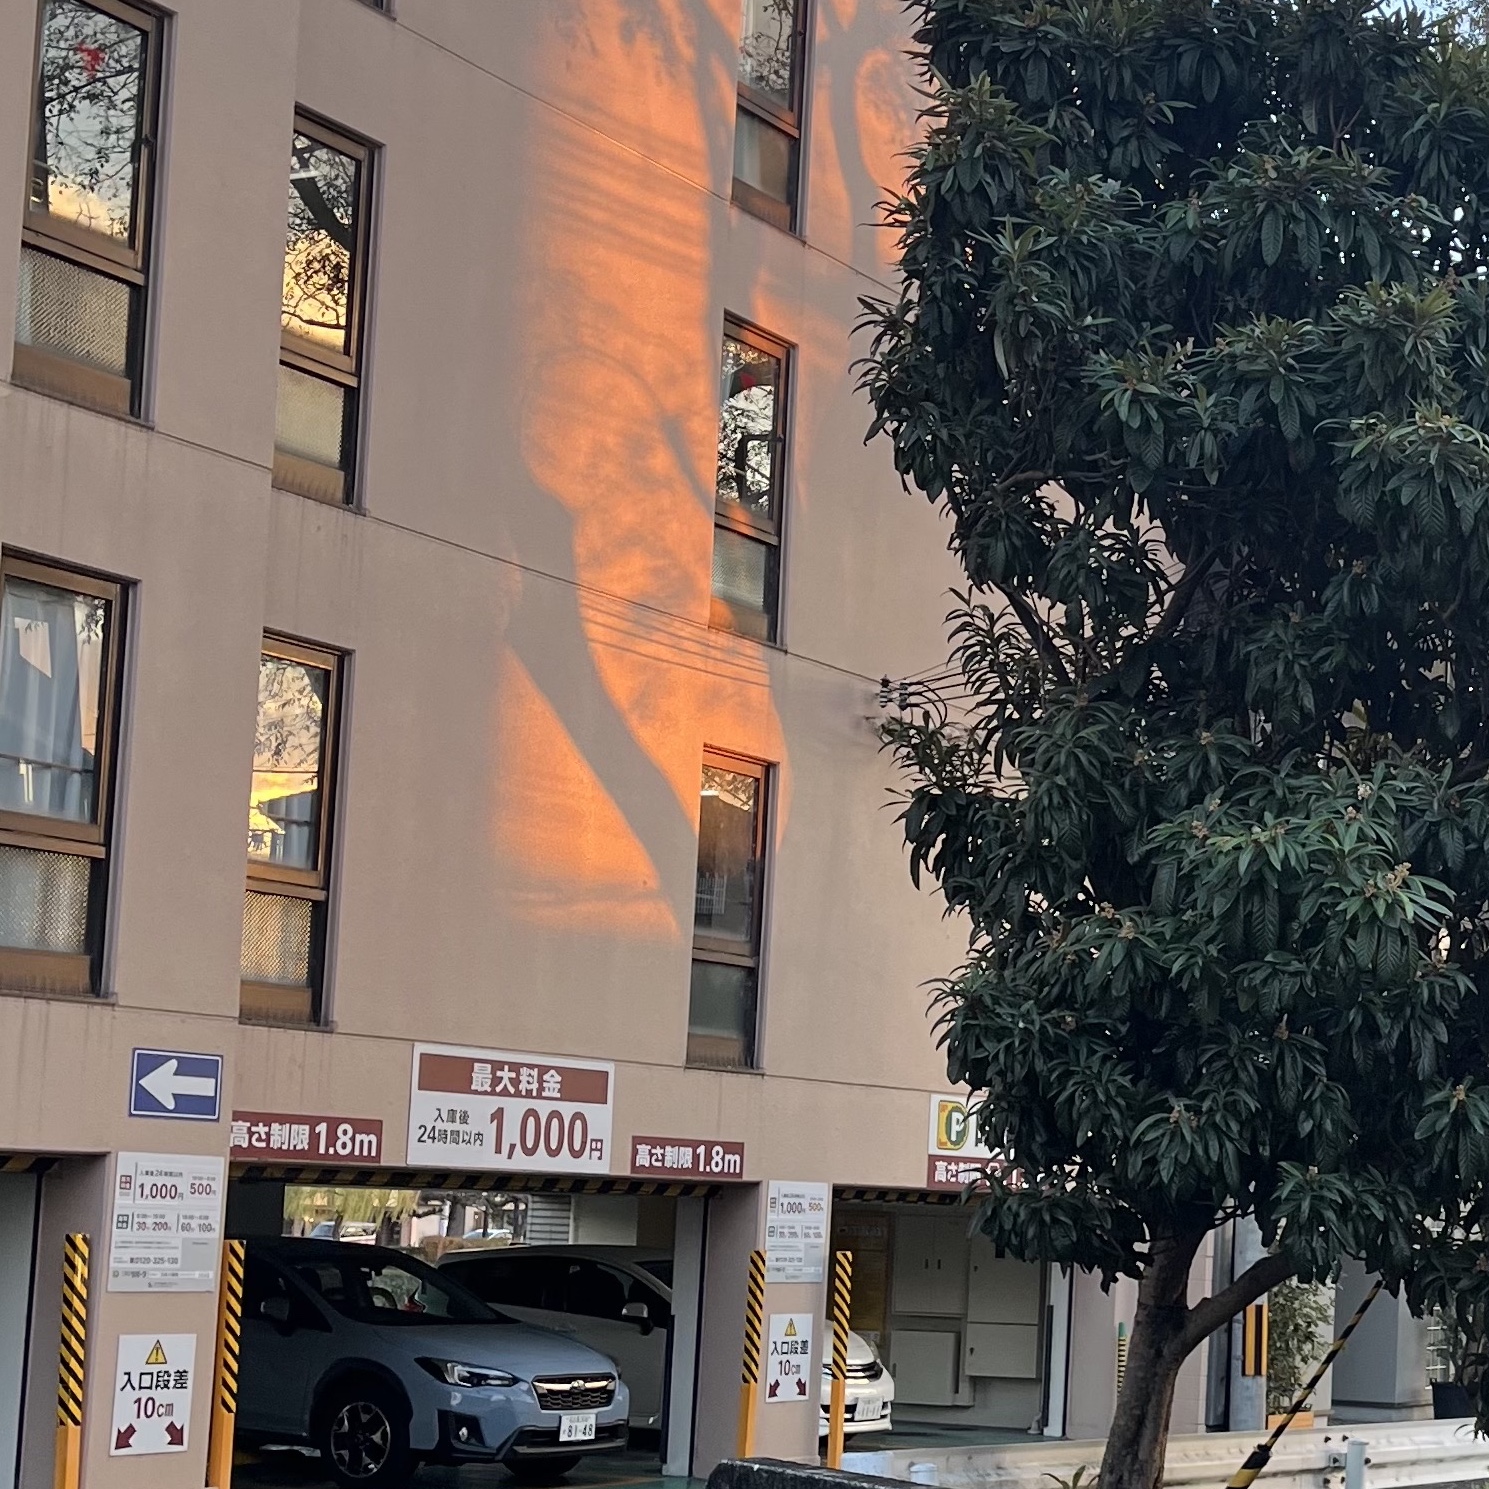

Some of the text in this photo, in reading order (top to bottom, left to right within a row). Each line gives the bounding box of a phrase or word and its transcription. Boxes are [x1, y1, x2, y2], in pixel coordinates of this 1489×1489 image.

[471, 1062, 562, 1098] 最大料金
[433, 1107, 470, 1125] 入庫後
[417, 1124, 484, 1147] 24時間以内
[490, 1106, 604, 1161] 1,000円
[769, 1339, 809, 1356] 入口段差
[120, 1369, 189, 1392] 入口段差
